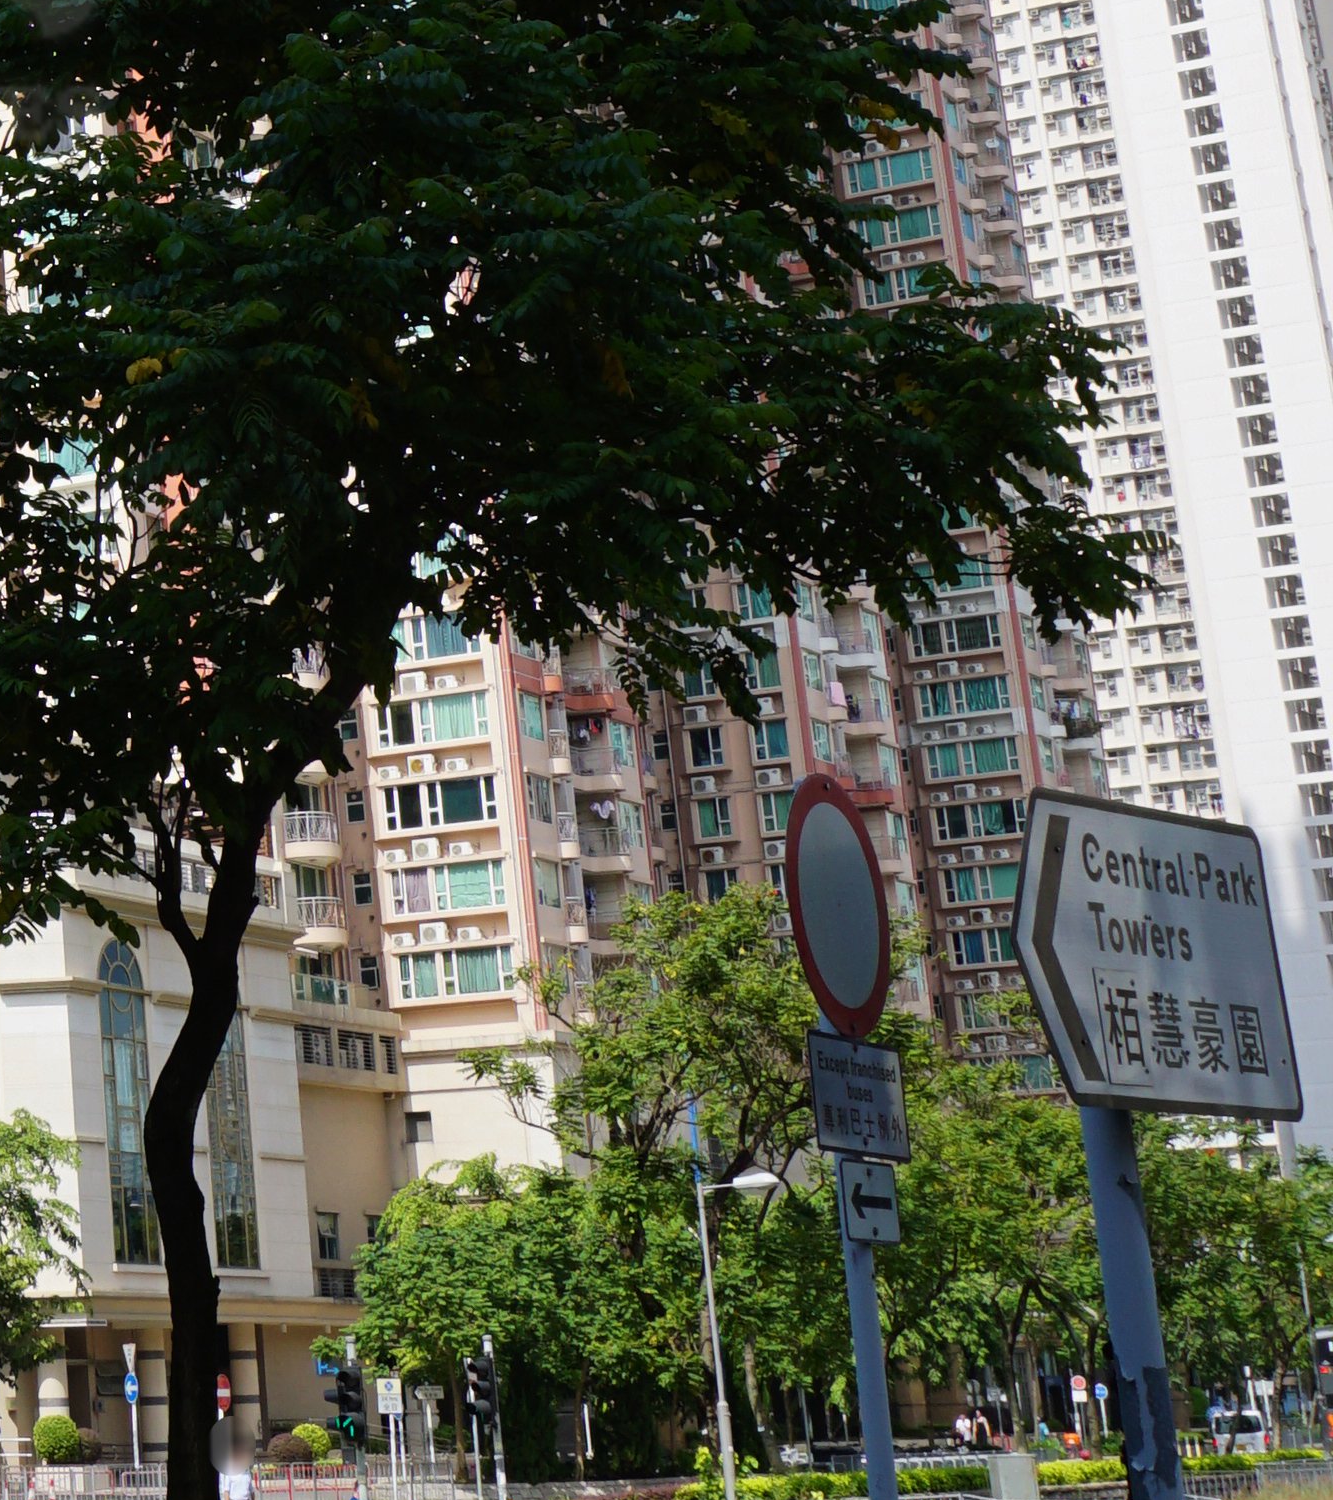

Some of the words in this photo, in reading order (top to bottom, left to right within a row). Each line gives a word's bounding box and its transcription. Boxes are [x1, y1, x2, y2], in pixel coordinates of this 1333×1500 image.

[1082, 832, 1190, 898] Central
[1198, 852, 1259, 907] Park
[1088, 902, 1193, 962] Towers
[817, 1050, 849, 1078] Except
[851, 1056, 896, 1083] franchised
[846, 1081, 873, 1103] buses
